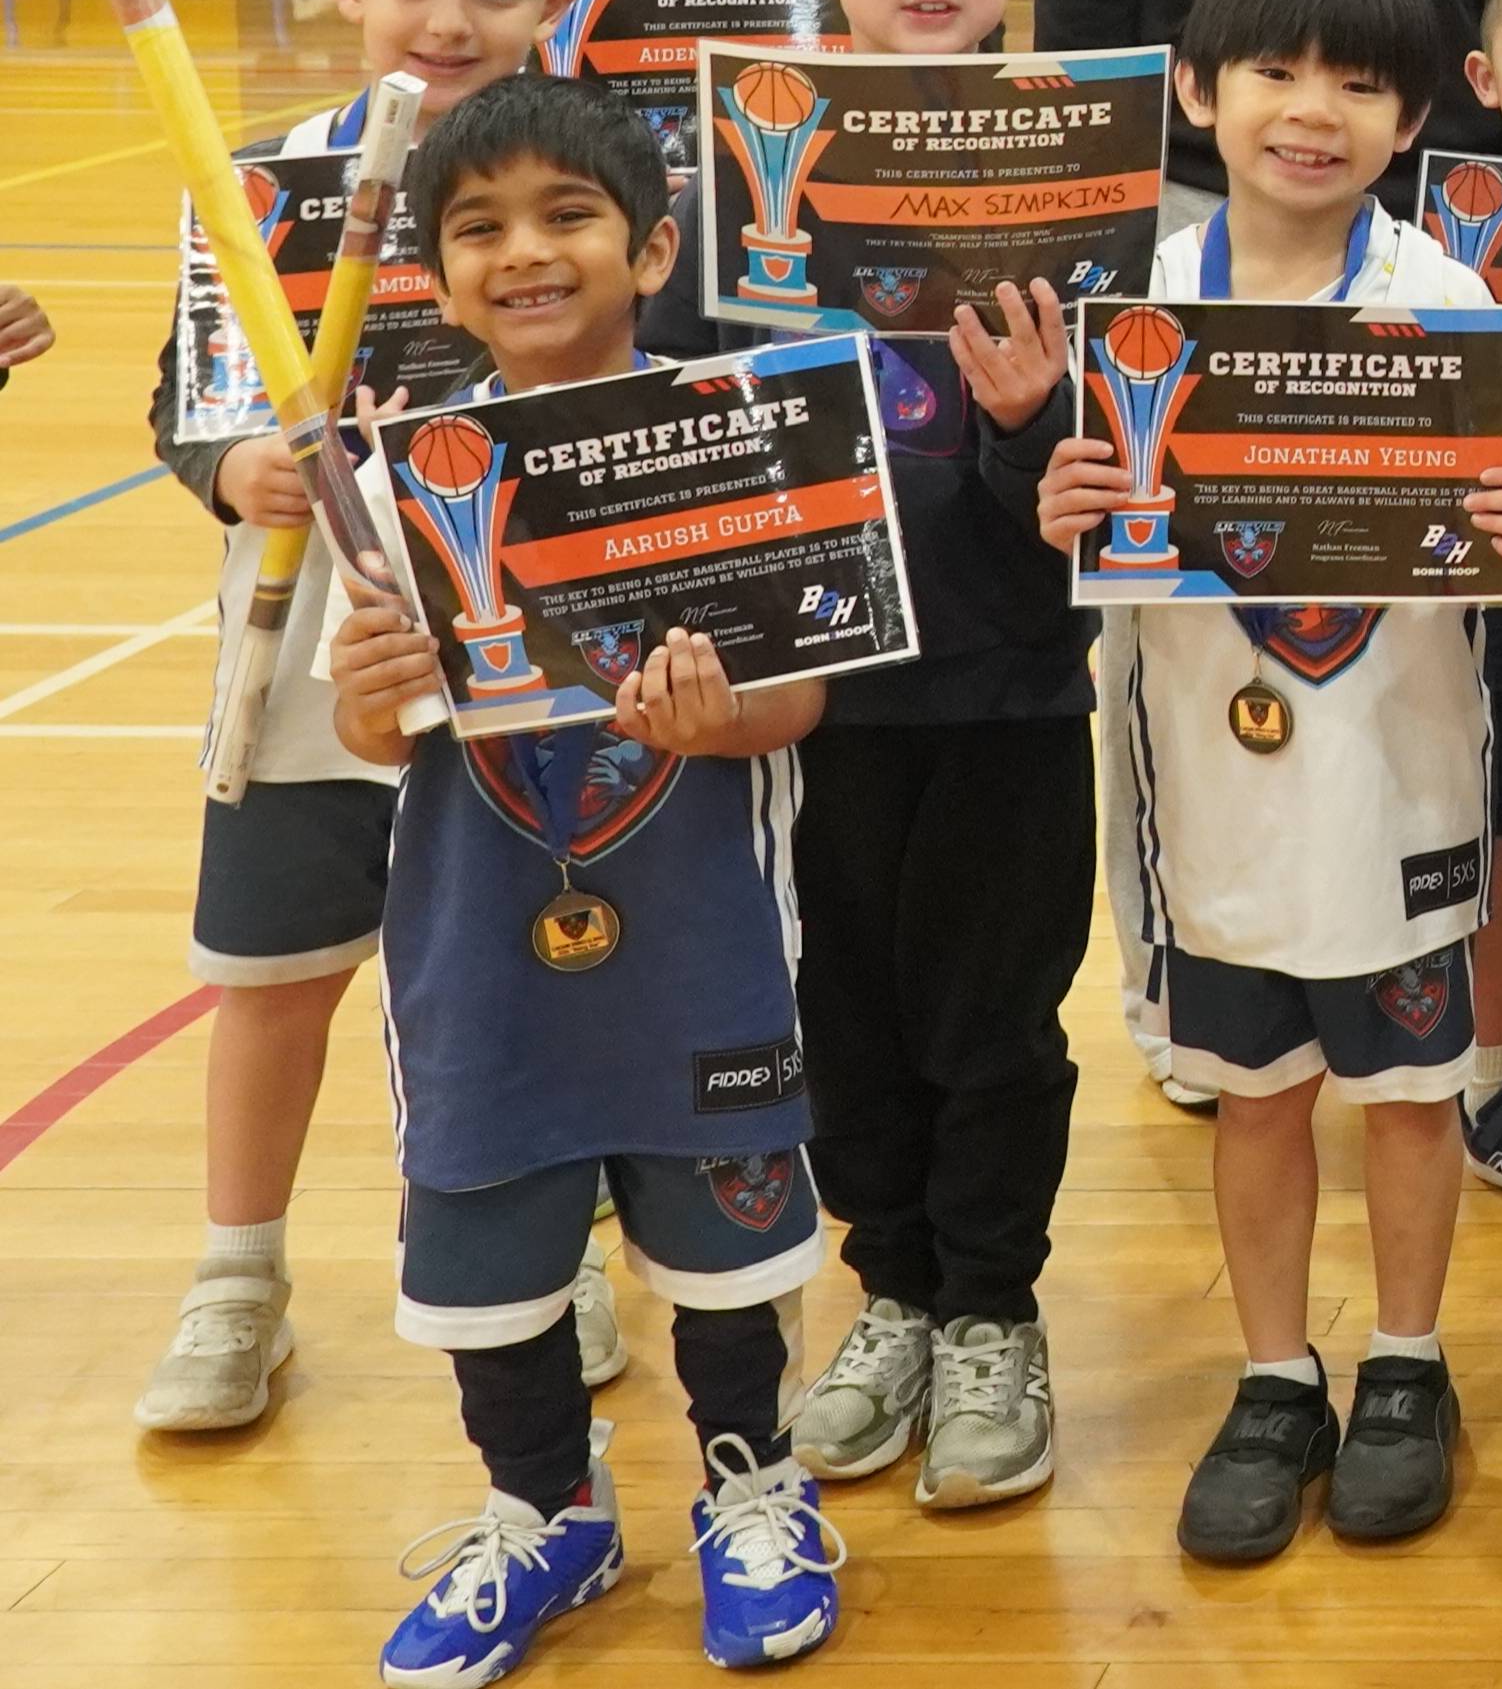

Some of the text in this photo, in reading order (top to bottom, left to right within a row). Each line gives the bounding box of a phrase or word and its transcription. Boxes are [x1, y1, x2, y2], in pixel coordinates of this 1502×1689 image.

[638, 44, 697, 63] AIDEN
[844, 103, 1111, 133] CERTIFICATE
[893, 133, 1065, 150] OF RECOGNITION
[875, 164, 1080, 178] THIS CERTIFICATE IS PRESENTED TO
[890, 181, 1126, 219] MAX SIMPKINS
[1209, 350, 1460, 381] CERTIFICATE
[1255, 380, 1417, 397] OF RECOGNITION
[522, 398, 809, 476] CERTIFICATE
[578, 437, 763, 487] OF RECOGNITION
[1243, 444, 1457, 468] JONATHAN YEUNG
[600, 499, 804, 562] AARUSH GUPTA
[1419, 524, 1473, 563] B2H
[1452, 862, 1475, 887] 5XS
[783, 1051, 803, 1081] 5XS
